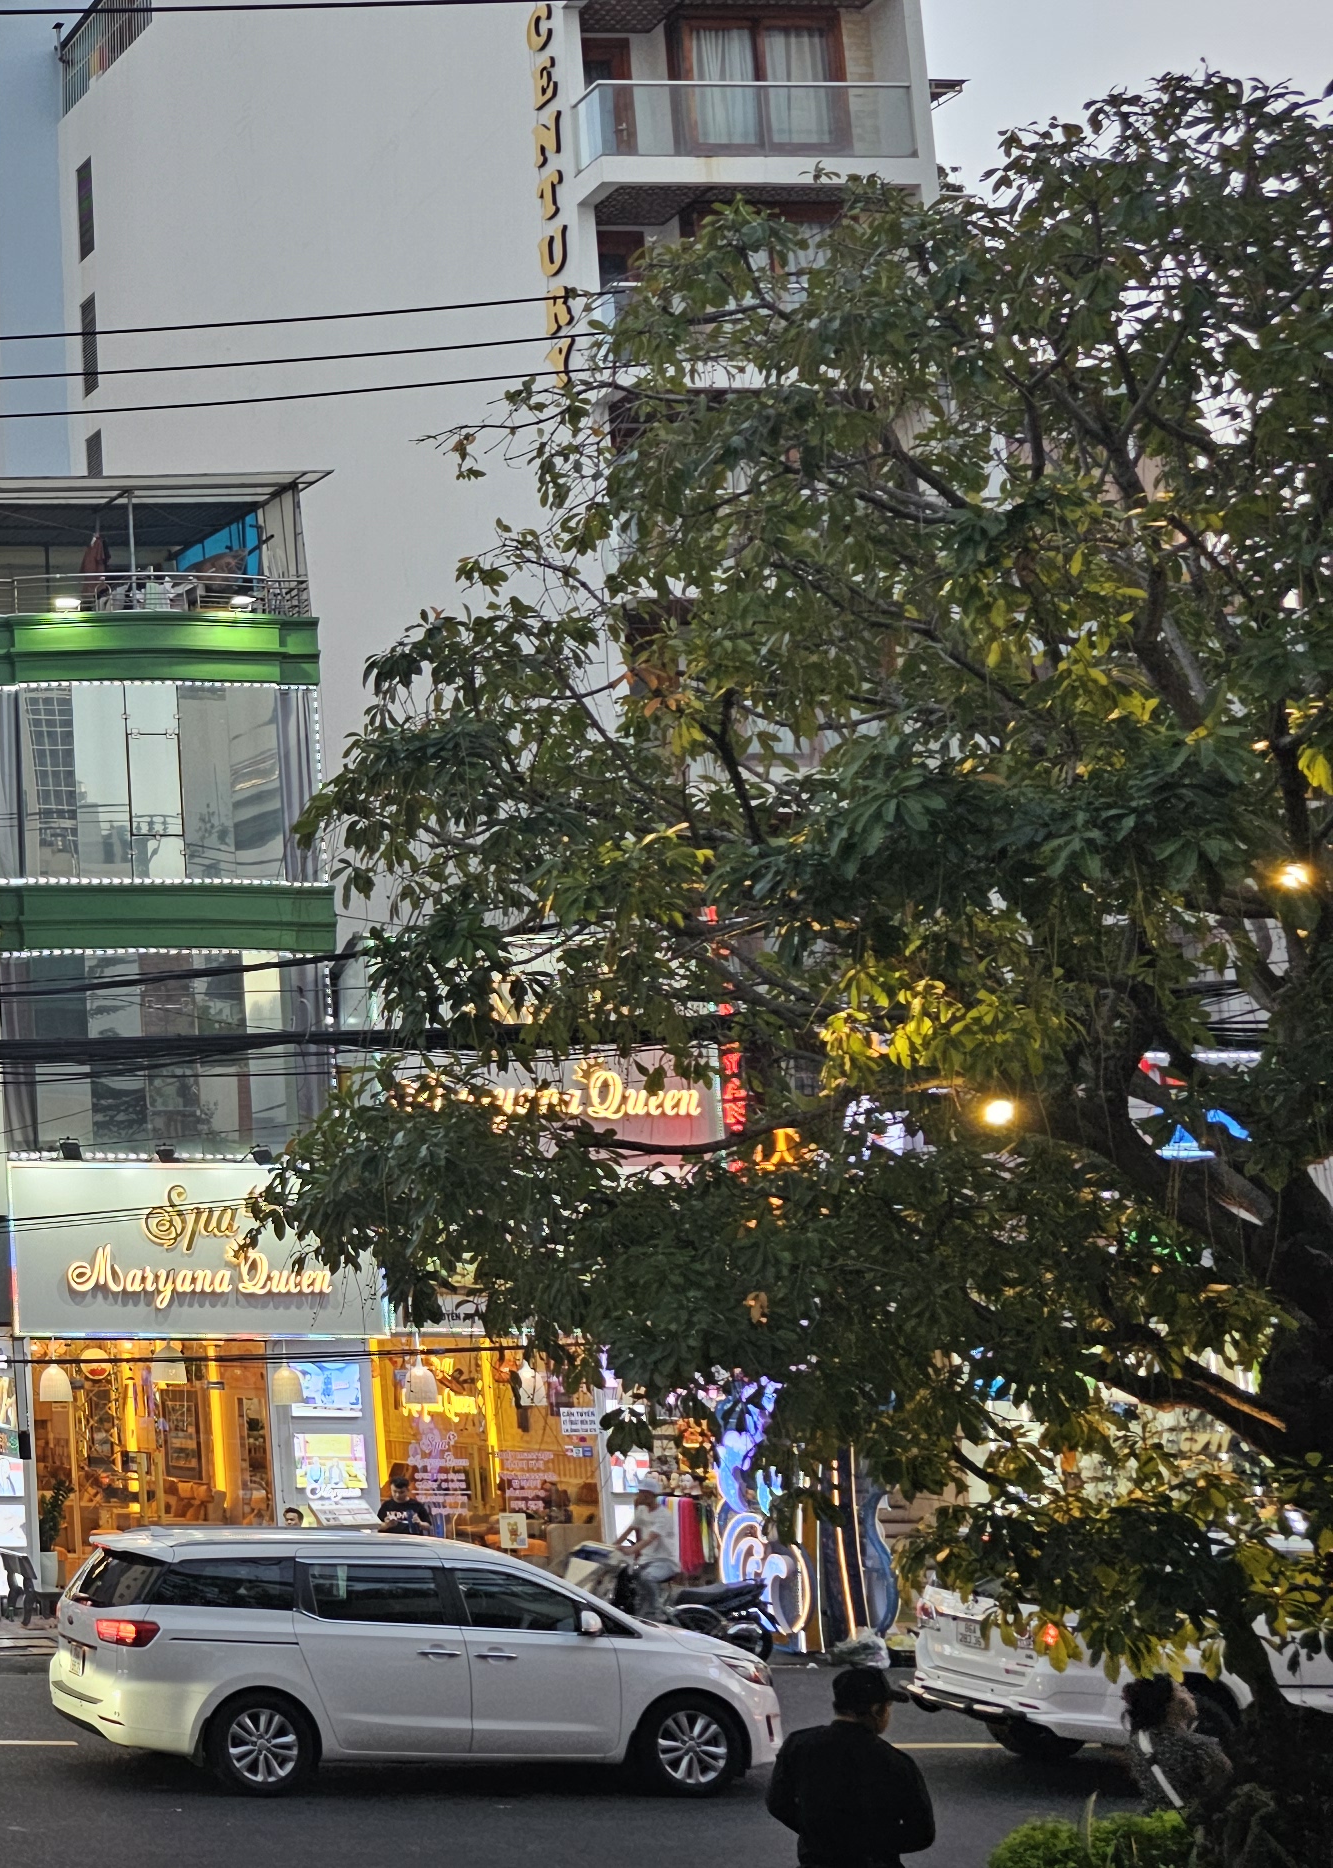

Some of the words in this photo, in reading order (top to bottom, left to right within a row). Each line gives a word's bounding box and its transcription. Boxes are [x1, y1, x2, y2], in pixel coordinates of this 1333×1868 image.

[527, 3, 575, 389] CENTURY
[587, 1069, 701, 1120] Queen
[143, 1184, 240, 1254] Spa
[67, 1242, 233, 1309] Maryana
[238, 1249, 333, 1295] Queen
